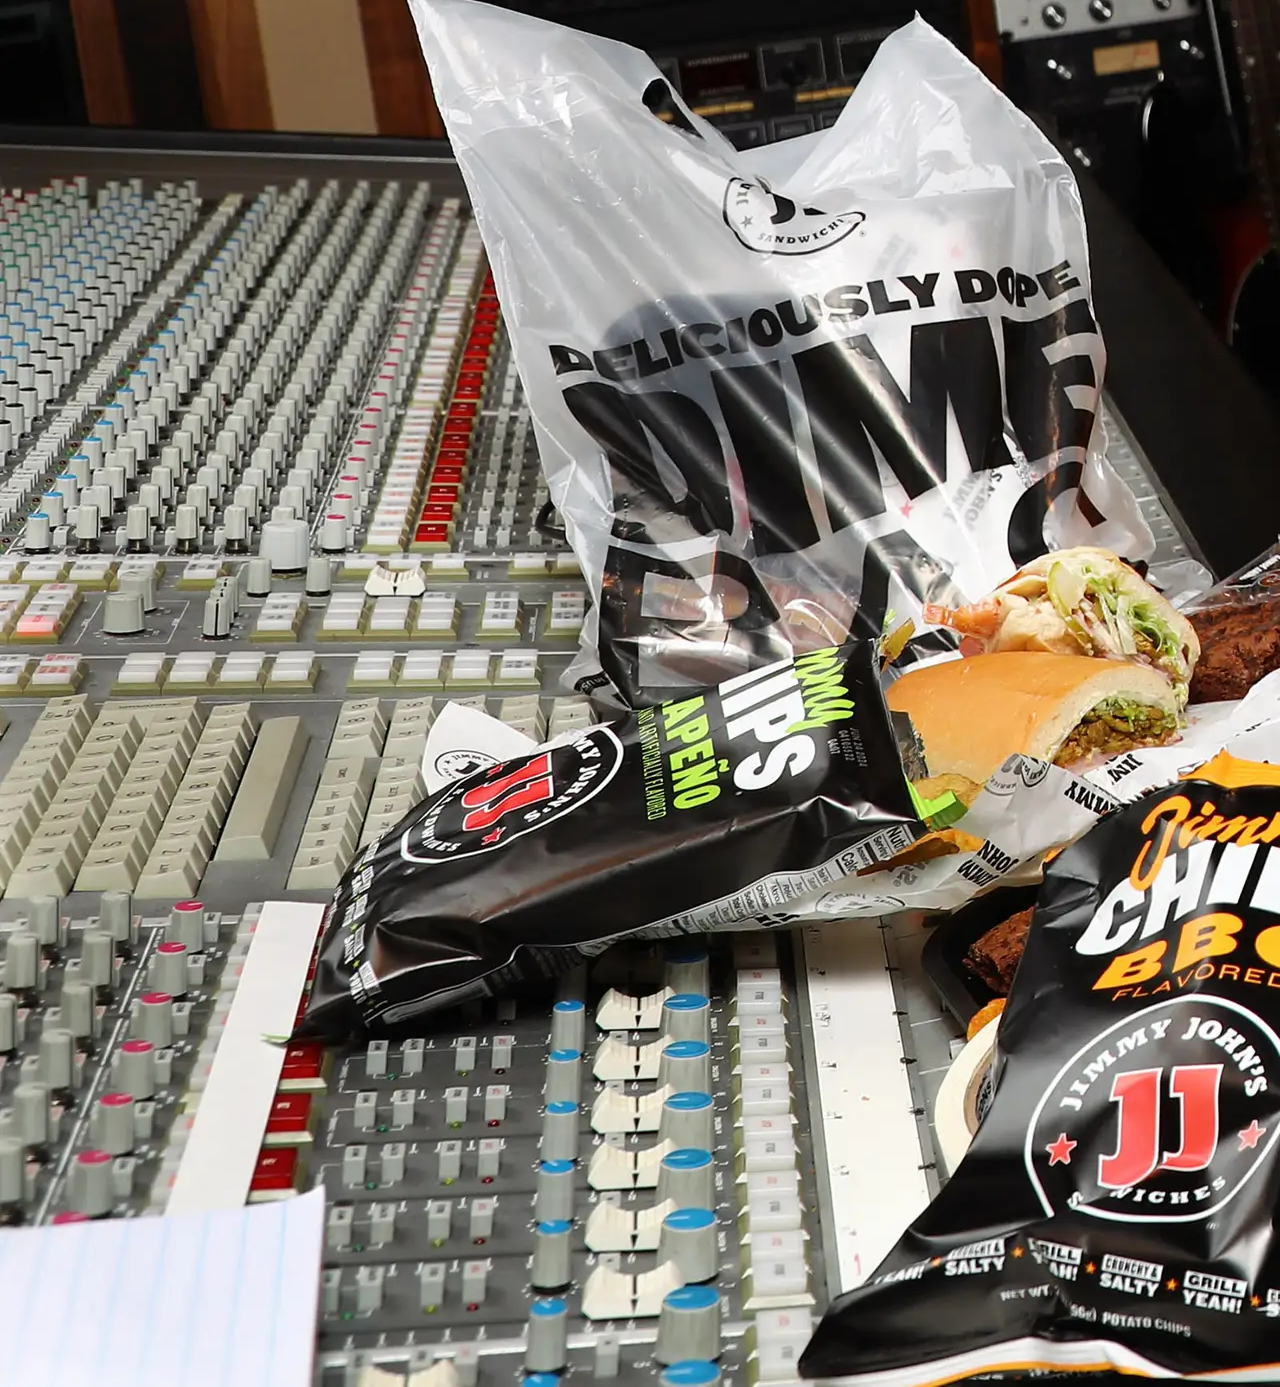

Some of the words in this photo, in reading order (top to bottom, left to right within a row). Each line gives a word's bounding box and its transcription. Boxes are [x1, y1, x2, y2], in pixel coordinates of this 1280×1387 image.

[549, 272, 941, 381] DELICIOUSLY
[954, 260, 1082, 310] DOPE
[562, 298, 1106, 557] DIME
[461, 752, 556, 832] JJ
[661, 696, 730, 810] APEÑO
[1060, 1018, 1172, 1111] JIMMY
[1181, 1017, 1268, 1097] JOHN'S
[1097, 1064, 1224, 1189] JJ
[944, 1257, 1007, 1277] SALTY
[1099, 1275, 1162, 1298] SALTY
[1183, 1288, 1243, 1315] YEAH!
[1185, 1271, 1247, 1298] GRILL
[1101, 1310, 1153, 1330] POTATO
